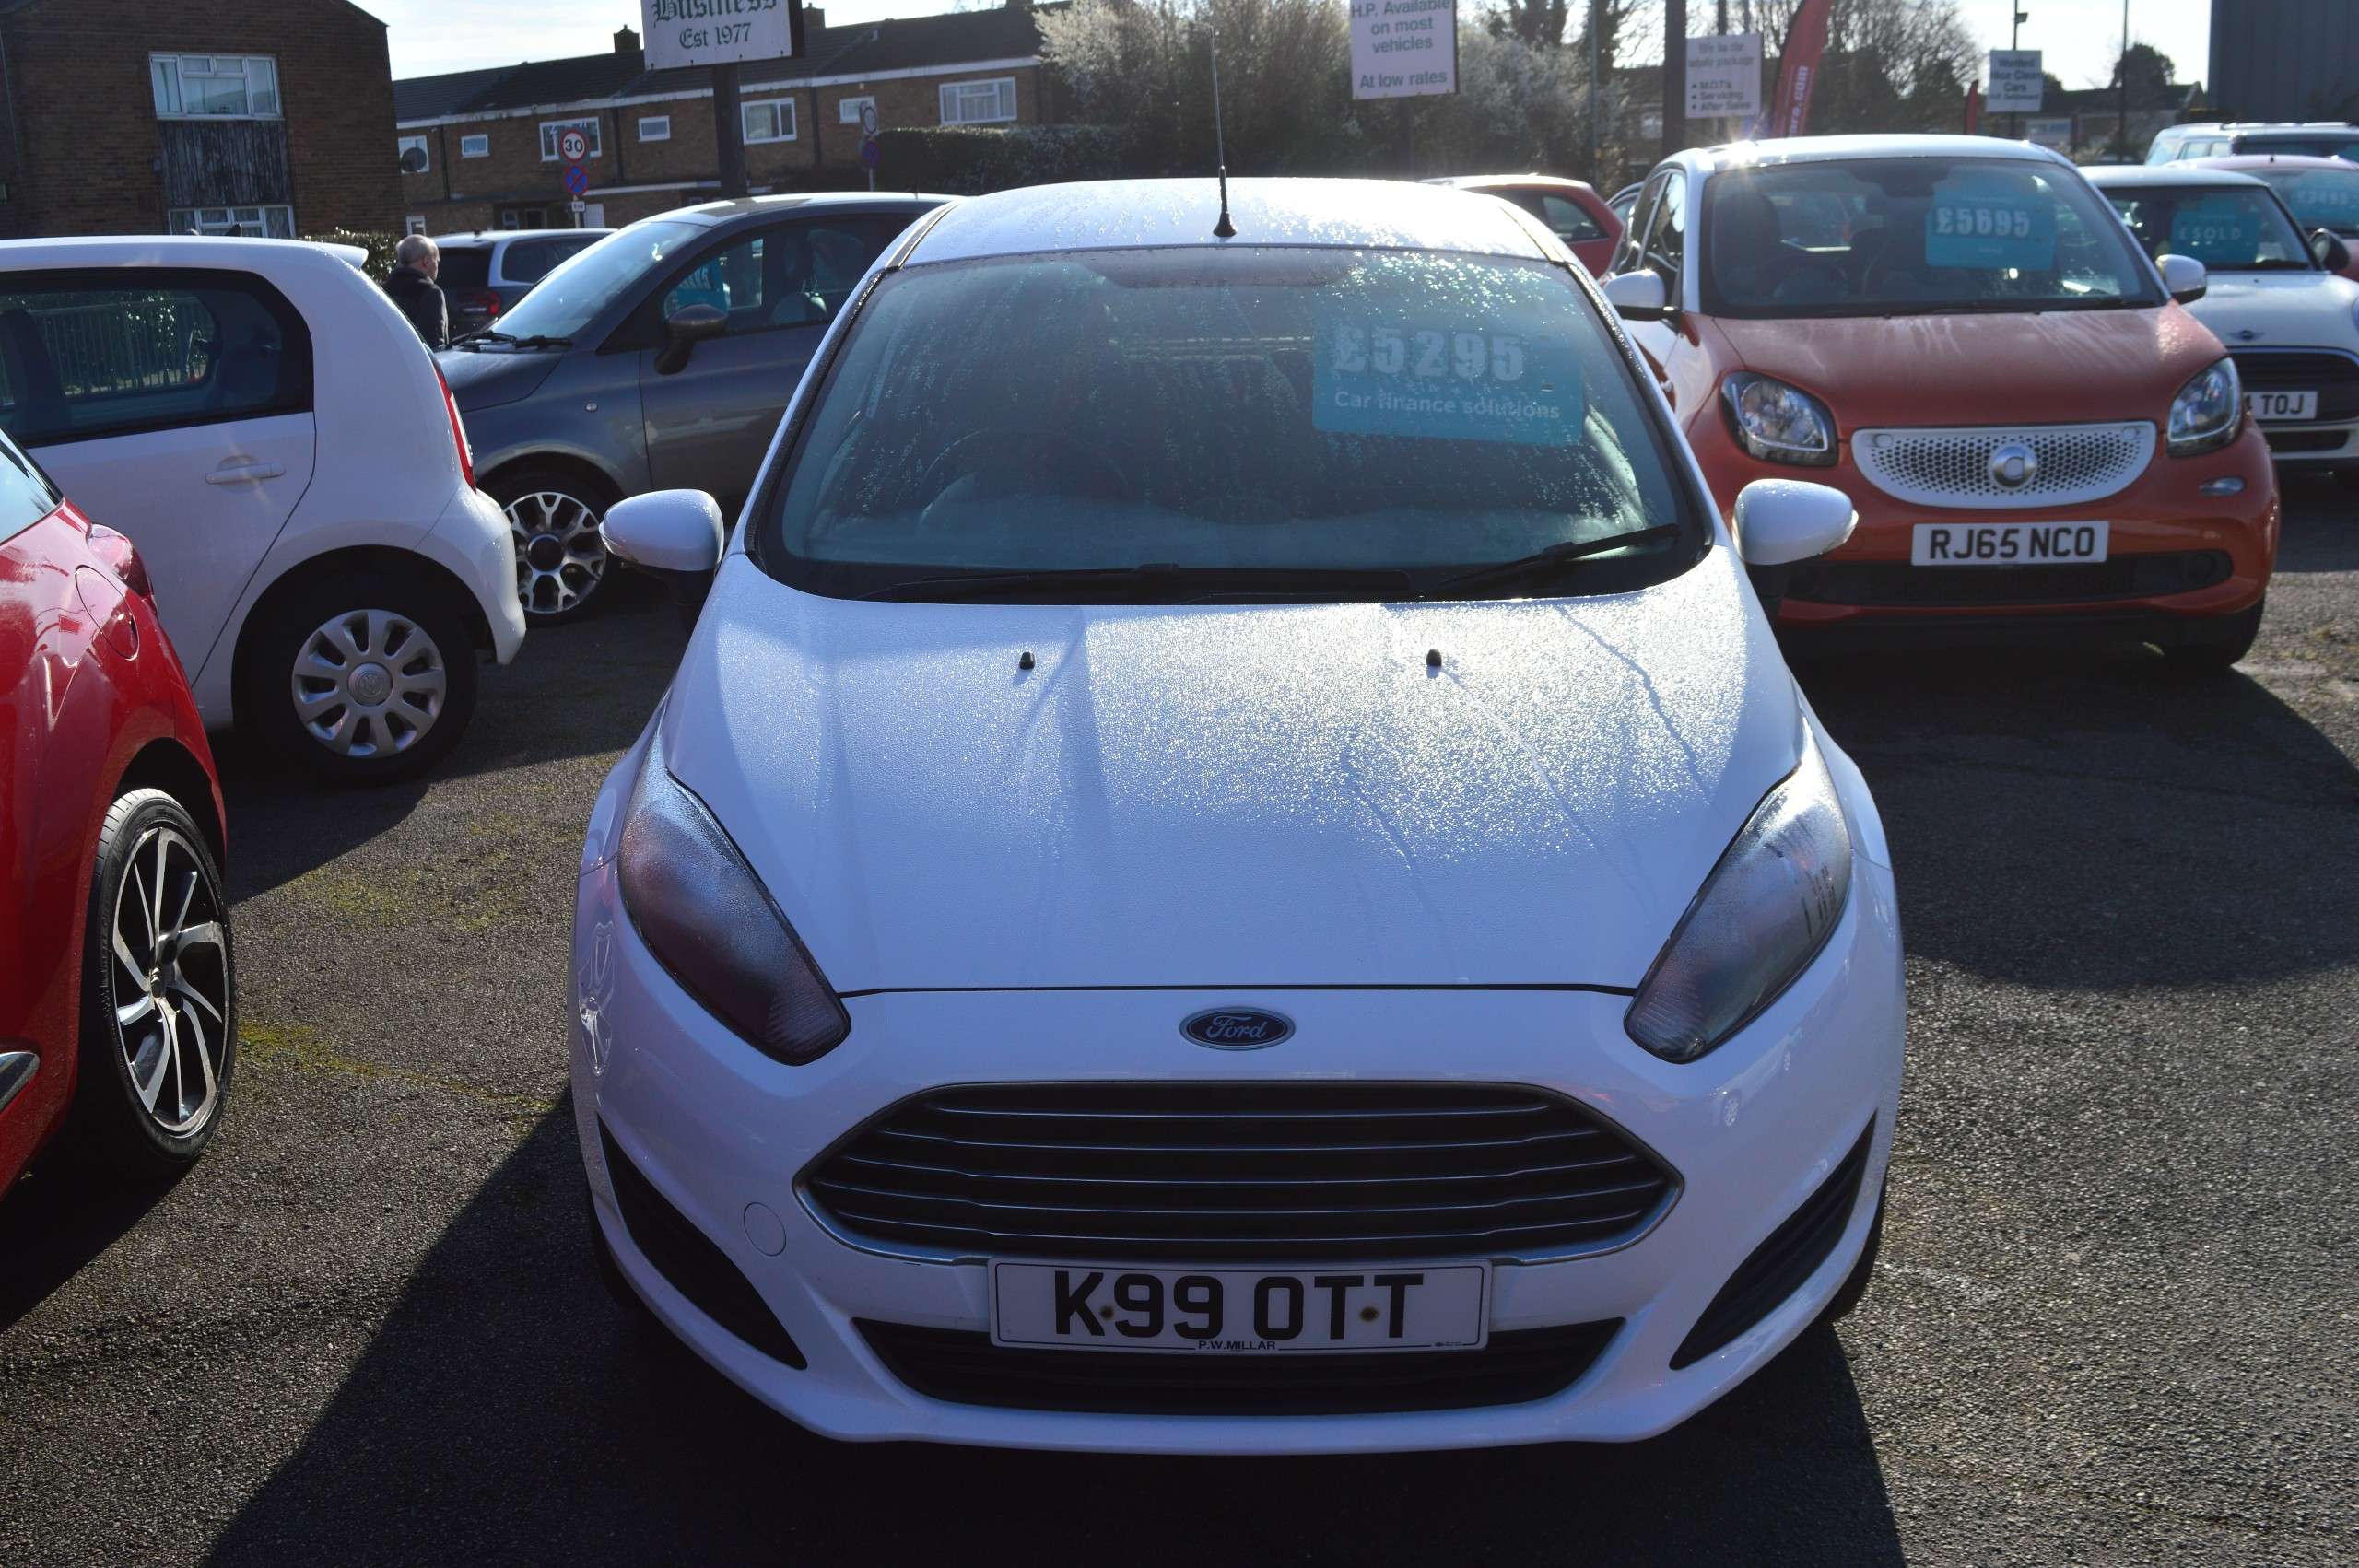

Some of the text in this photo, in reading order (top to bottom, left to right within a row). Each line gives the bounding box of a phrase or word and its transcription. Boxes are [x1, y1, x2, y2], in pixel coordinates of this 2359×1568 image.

[679, 22, 752, 49] Est 1977
[1371, 17, 1434, 35] on most
[1372, 36, 1433, 53] vehicles
[1360, 71, 1448, 88] At low rates
[565, 139, 583, 152] 30
[1937, 206, 2030, 238] £5695
[1333, 324, 1523, 381] £5295
[1335, 391, 1561, 420] Car finance solutions
[2260, 394, 2305, 415] TOJ
[1929, 526, 2095, 560] RJ65 NCO
[1206, 1015, 1268, 1039] Ford
[1054, 1270, 1425, 1340] K99 OTT
